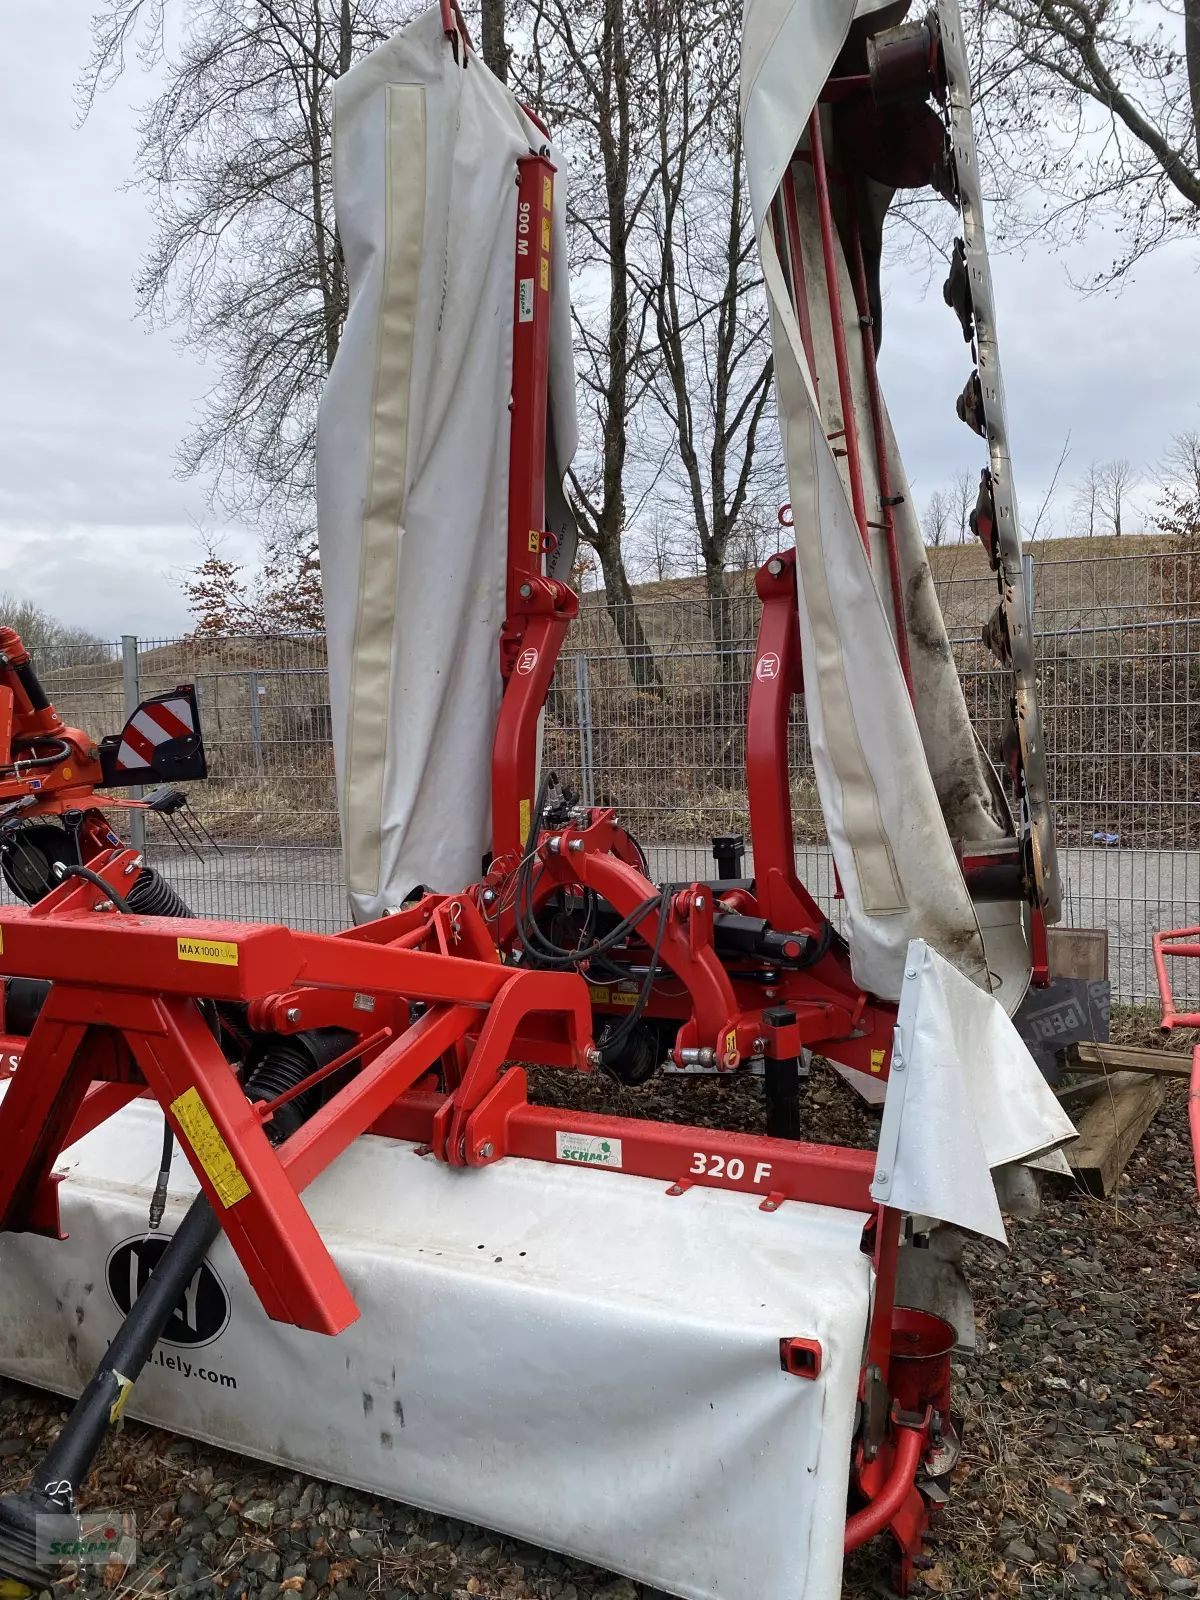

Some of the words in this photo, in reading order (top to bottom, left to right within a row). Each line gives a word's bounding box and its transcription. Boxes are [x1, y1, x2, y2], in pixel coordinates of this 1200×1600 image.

[519, 202, 530, 233] 900
[518, 239, 529, 255] M
[1030, 1008, 1079, 1039] PERI
[689, 1152, 745, 1180] 320
[753, 1162, 772, 1184] F
